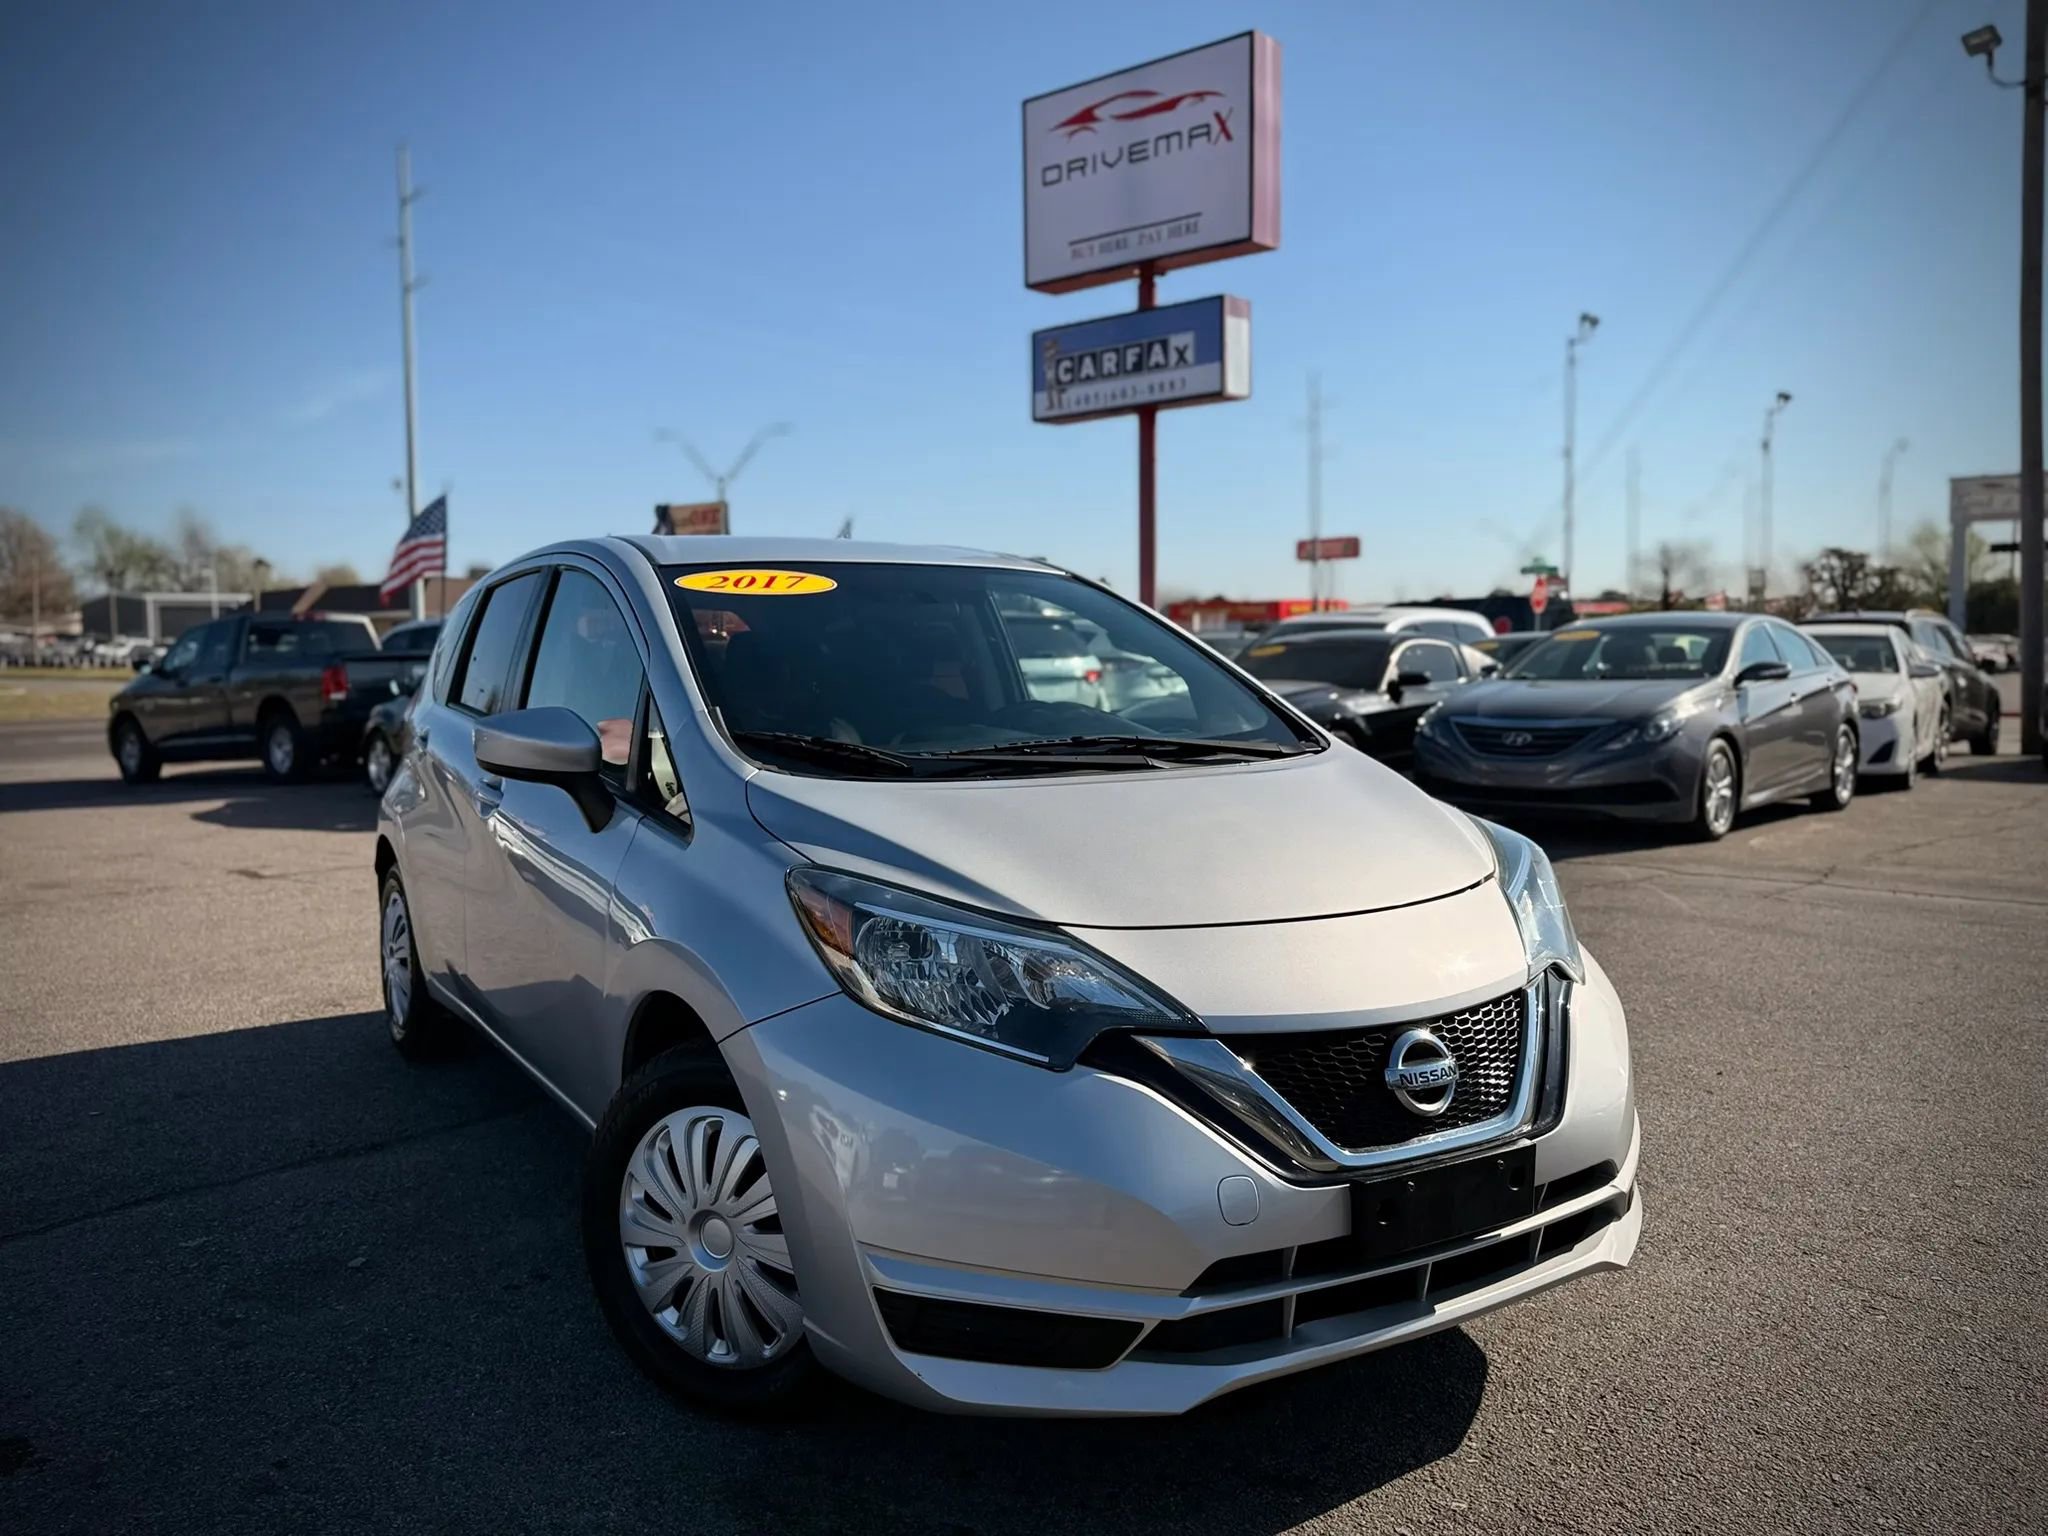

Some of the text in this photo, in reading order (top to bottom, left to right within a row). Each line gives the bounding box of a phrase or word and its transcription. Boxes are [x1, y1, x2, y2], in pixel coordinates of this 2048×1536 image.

[1041, 107, 1234, 188] DRIVEMAX
[1057, 341, 1191, 383] CARFAX
[706, 575, 807, 589] 2017
[1399, 1065, 1457, 1086] NISSAN
